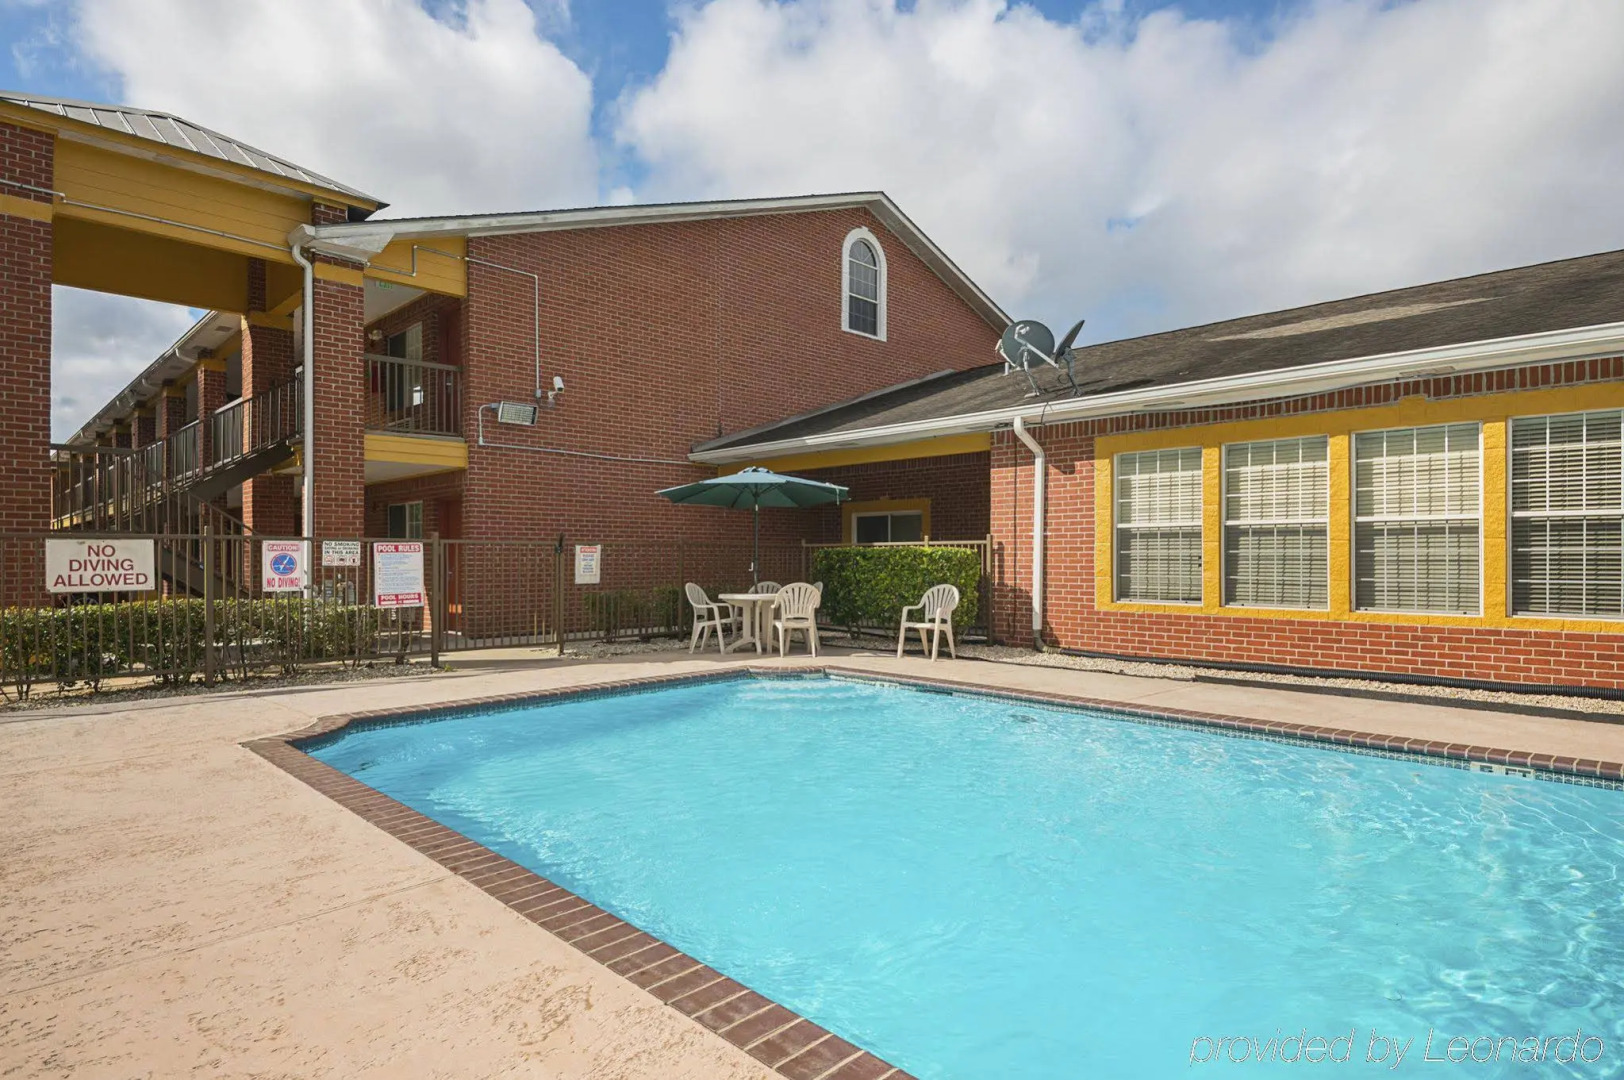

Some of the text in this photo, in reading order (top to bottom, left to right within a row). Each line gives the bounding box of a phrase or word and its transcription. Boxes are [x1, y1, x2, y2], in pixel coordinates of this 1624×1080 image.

[87, 545, 116, 558] NO
[69, 558, 134, 572] DIVING
[53, 573, 148, 587] ALLOWED
[266, 577, 276, 588] NO
